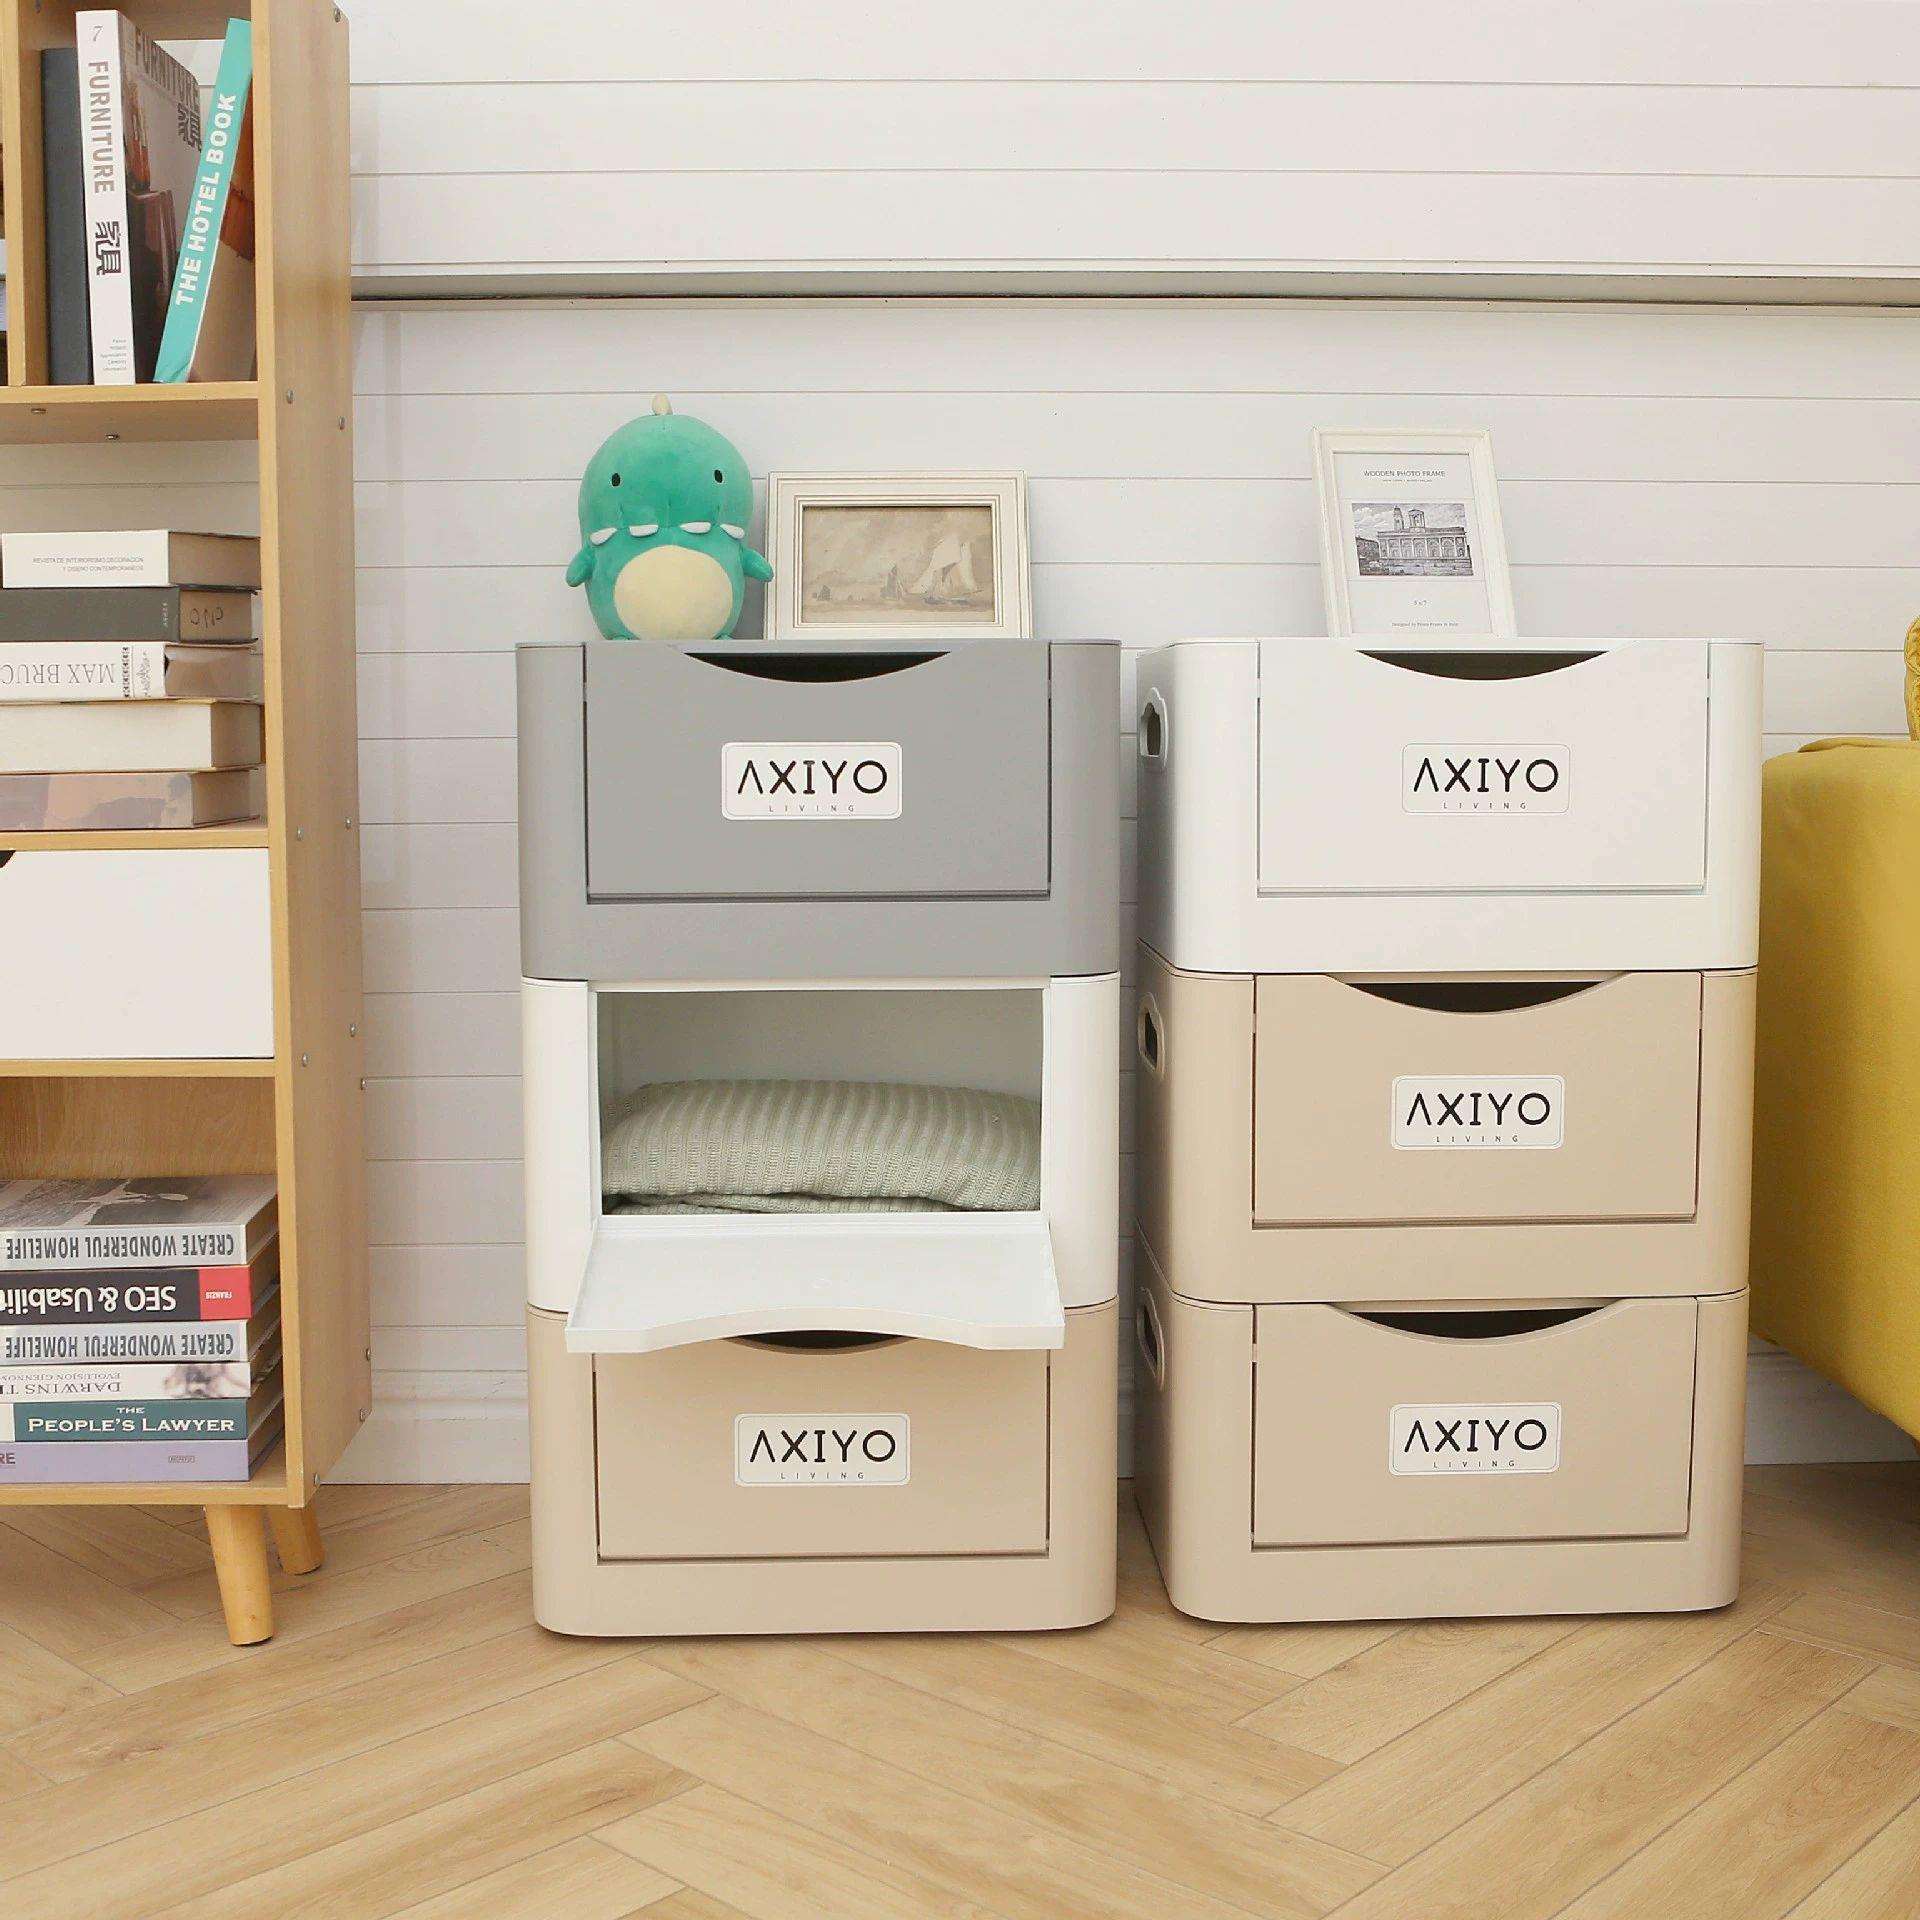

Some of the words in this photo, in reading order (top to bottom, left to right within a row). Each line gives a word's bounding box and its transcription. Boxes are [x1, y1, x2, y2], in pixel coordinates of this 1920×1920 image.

[92, 25, 104, 42] 7
[88, 60, 115, 195] FURNITURE
[205, 92, 237, 165] BOOK
[187, 171, 220, 252] HOTEL
[94, 220, 122, 276] 家具
[175, 257, 203, 306] THE
[1422, 470, 1446, 478] FRAME
[68, 663, 115, 684] MAX
[737, 759, 888, 795] AXIYO
[1413, 757, 1559, 793] AXIYO
[769, 804, 856, 813] LIVING
[1406, 1092, 1551, 1126] AXIYO
[1435, 1134, 1519, 1143] LIVING
[5, 1237, 79, 1260] HOMELIFE
[85, 1235, 177, 1258] WONDERFUL
[182, 1234, 235, 1257] CREATE
[98, 1287, 119, 1312] &
[124, 1285, 177, 1311] SEO
[5, 1336, 78, 1358] HOMELIFE
[84, 1334, 176, 1357] WONDERFUL
[181, 1333, 234, 1356] CREATE
[25, 1381, 120, 1394] DARWINS
[116, 1406, 145, 1414] THE
[27, 1418, 134, 1432] PEOPLE'S
[142, 1418, 235, 1432] LAWYER
[1404, 1419, 1547, 1453] AXIYO
[749, 1429, 896, 1463] AXIYO
[1433, 1460, 1515, 1468] LIVING
[780, 1472, 865, 1480] LIVING
